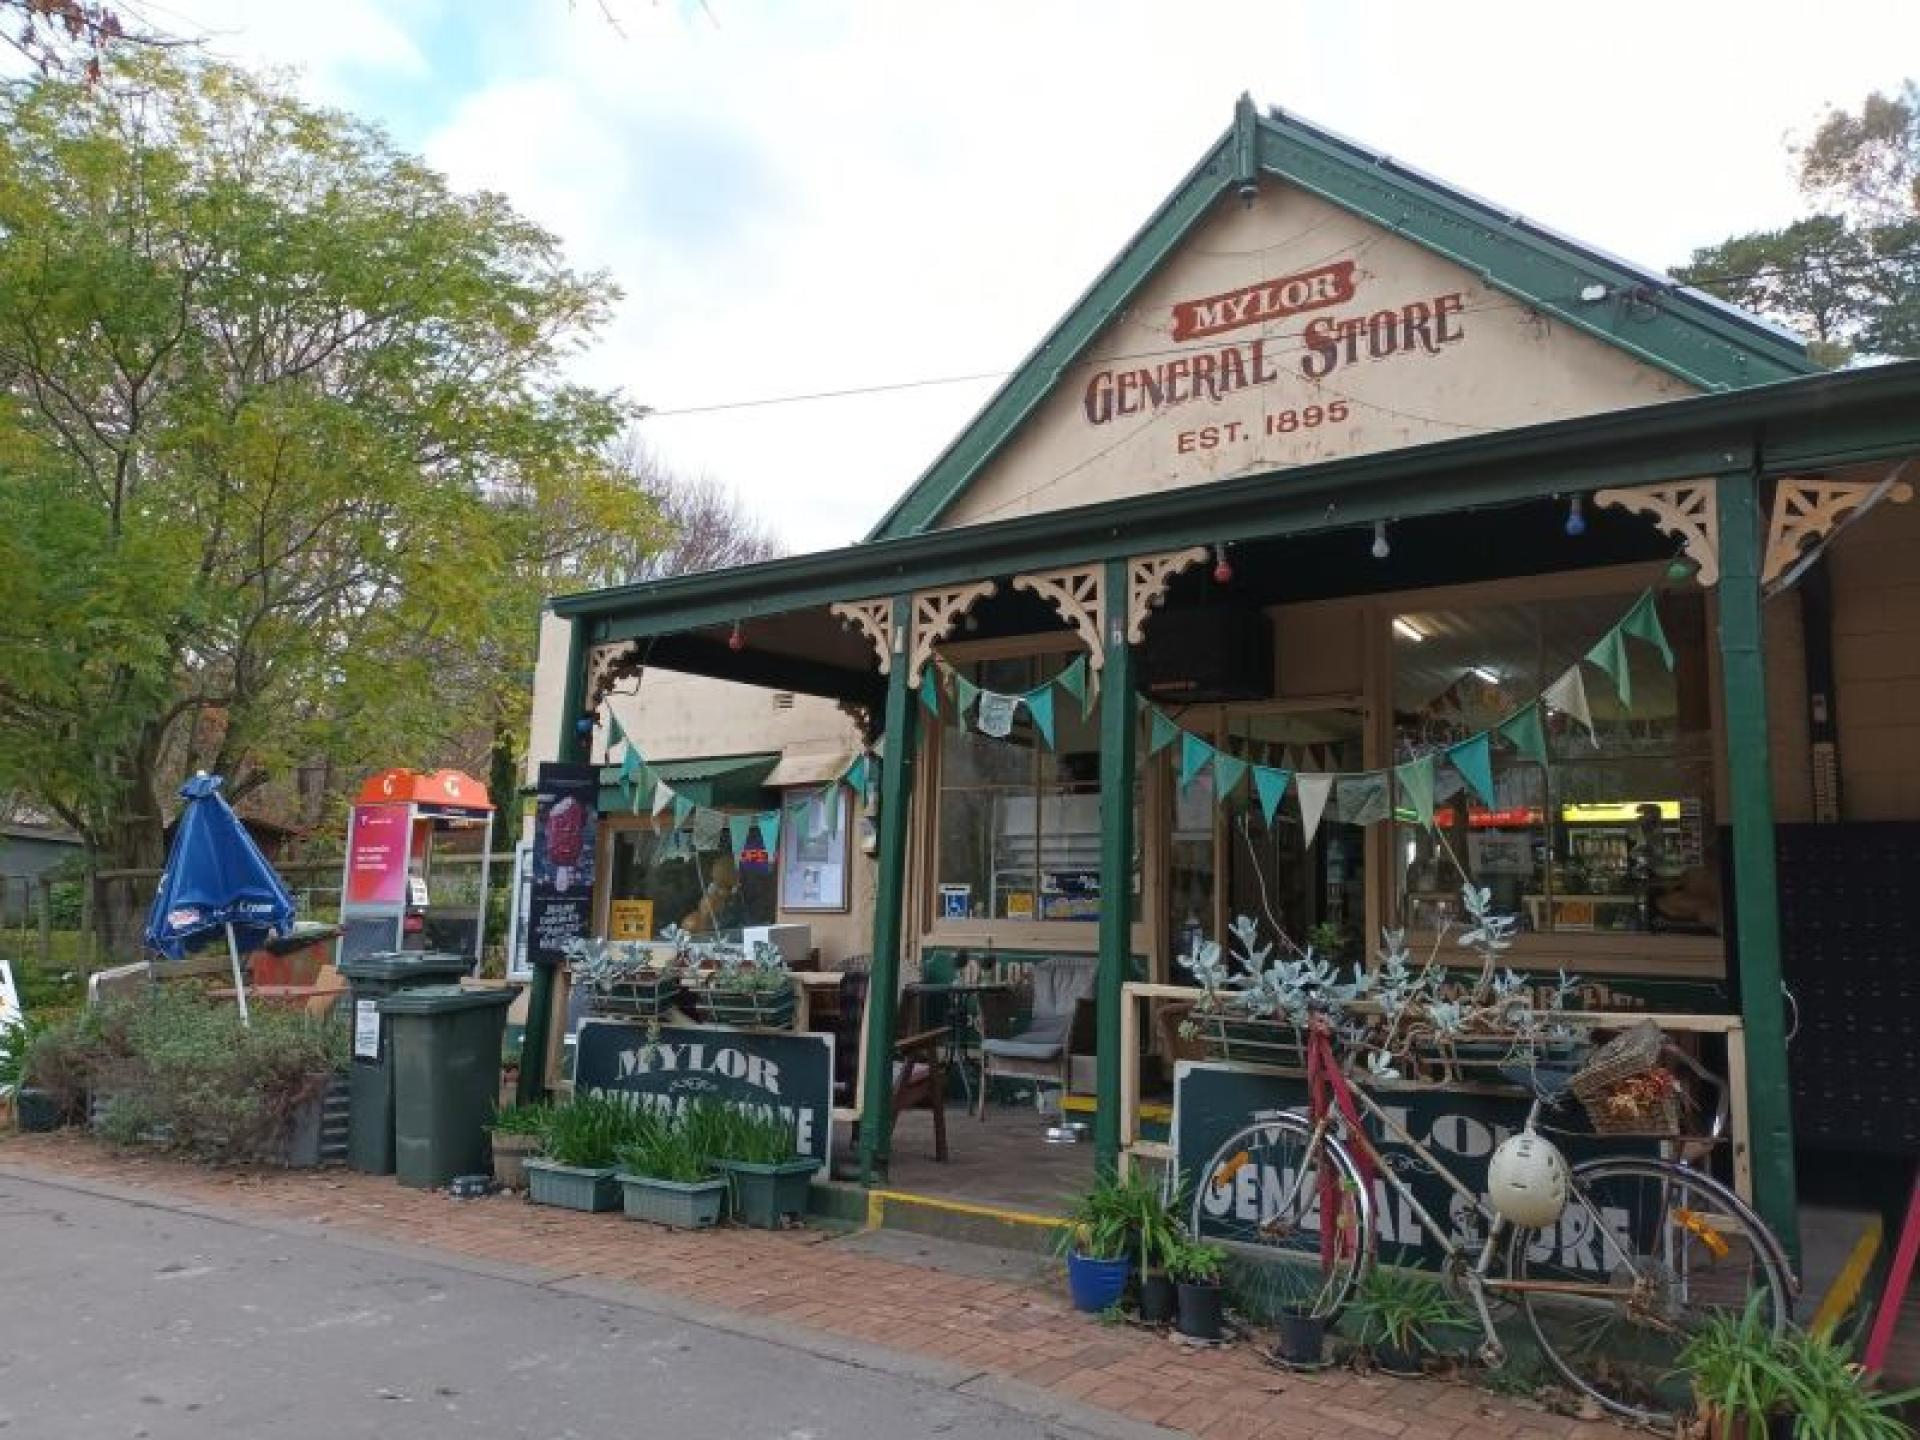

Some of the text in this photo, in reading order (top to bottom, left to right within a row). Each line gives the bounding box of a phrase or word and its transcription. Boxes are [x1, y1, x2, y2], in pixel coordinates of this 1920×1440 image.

[1195, 273, 1340, 329] MYLOR
[1085, 293, 1465, 425] GENERAL STORE
[1178, 401, 1350, 454] EST. 1895
[614, 1043, 781, 1095] MYLOR
